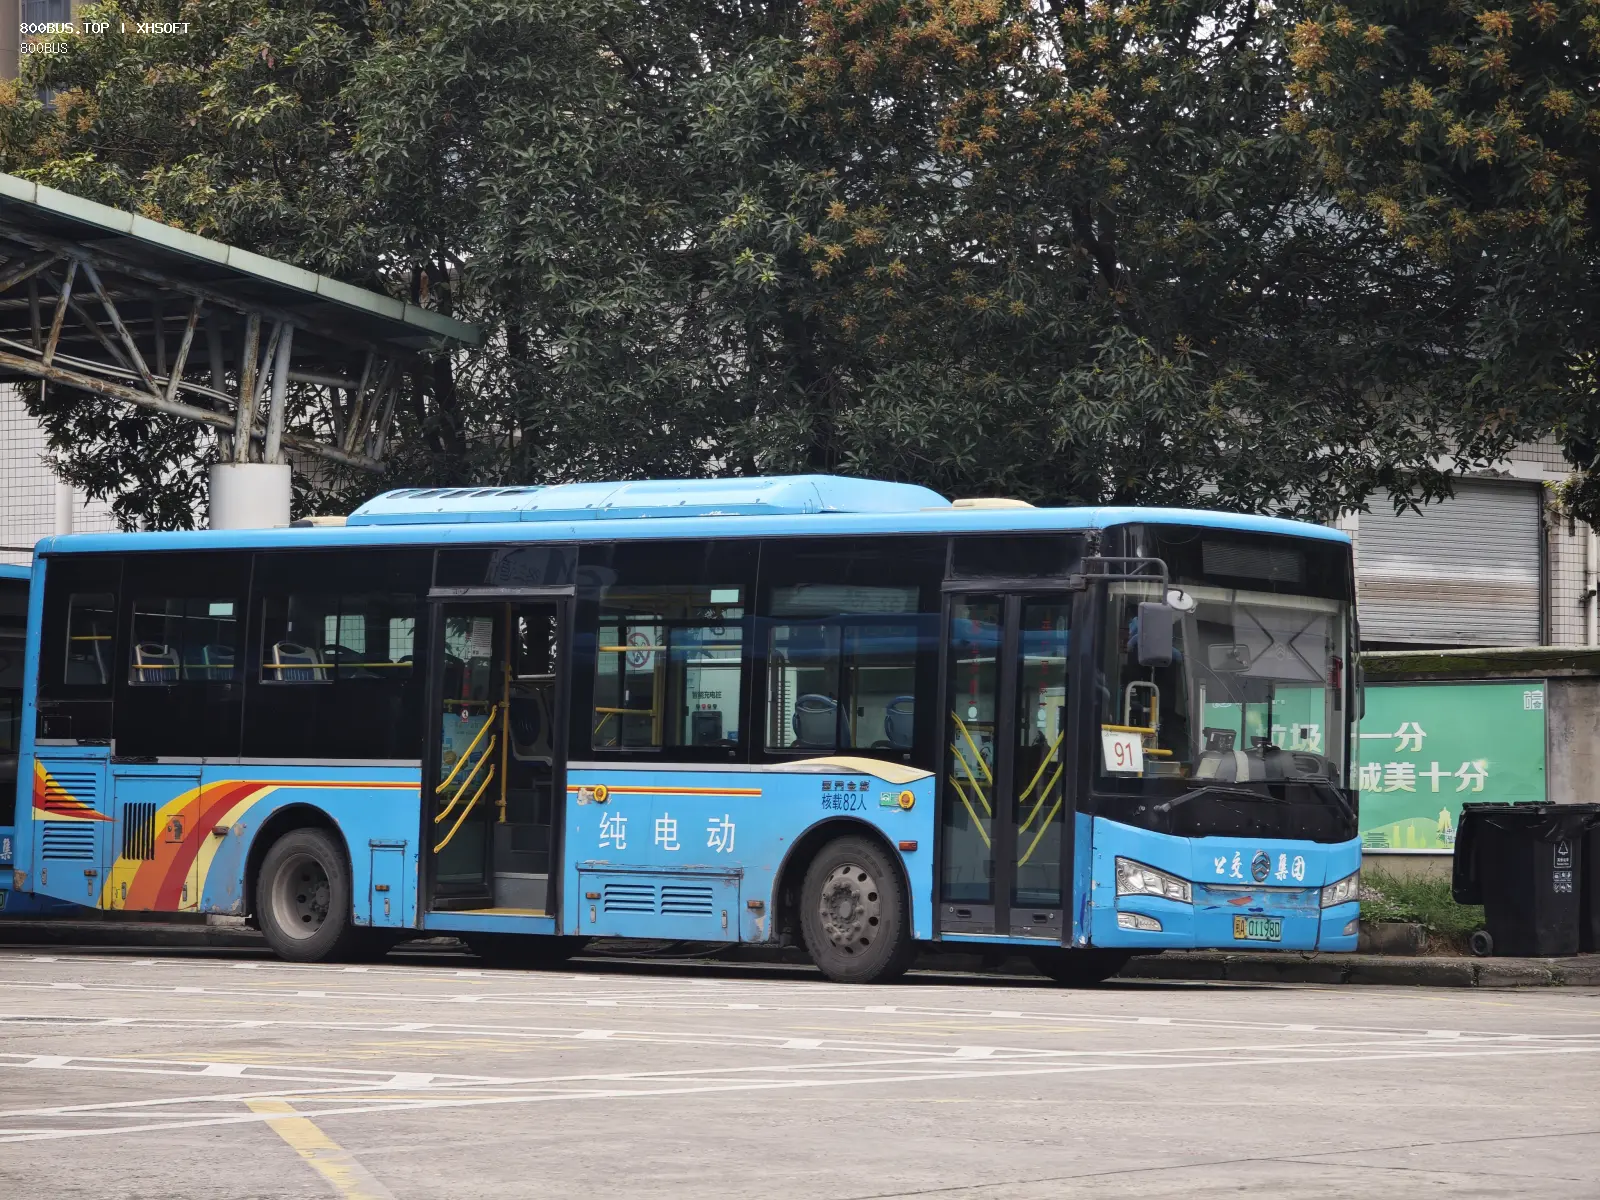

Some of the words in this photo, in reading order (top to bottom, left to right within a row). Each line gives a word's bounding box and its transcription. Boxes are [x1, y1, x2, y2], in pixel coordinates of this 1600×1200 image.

[1114, 741, 1133, 767] 91
[821, 793, 867, 811] 核载82人
[598, 811, 736, 853] 纯电动
[1274, 853, 1306, 881] 集团
